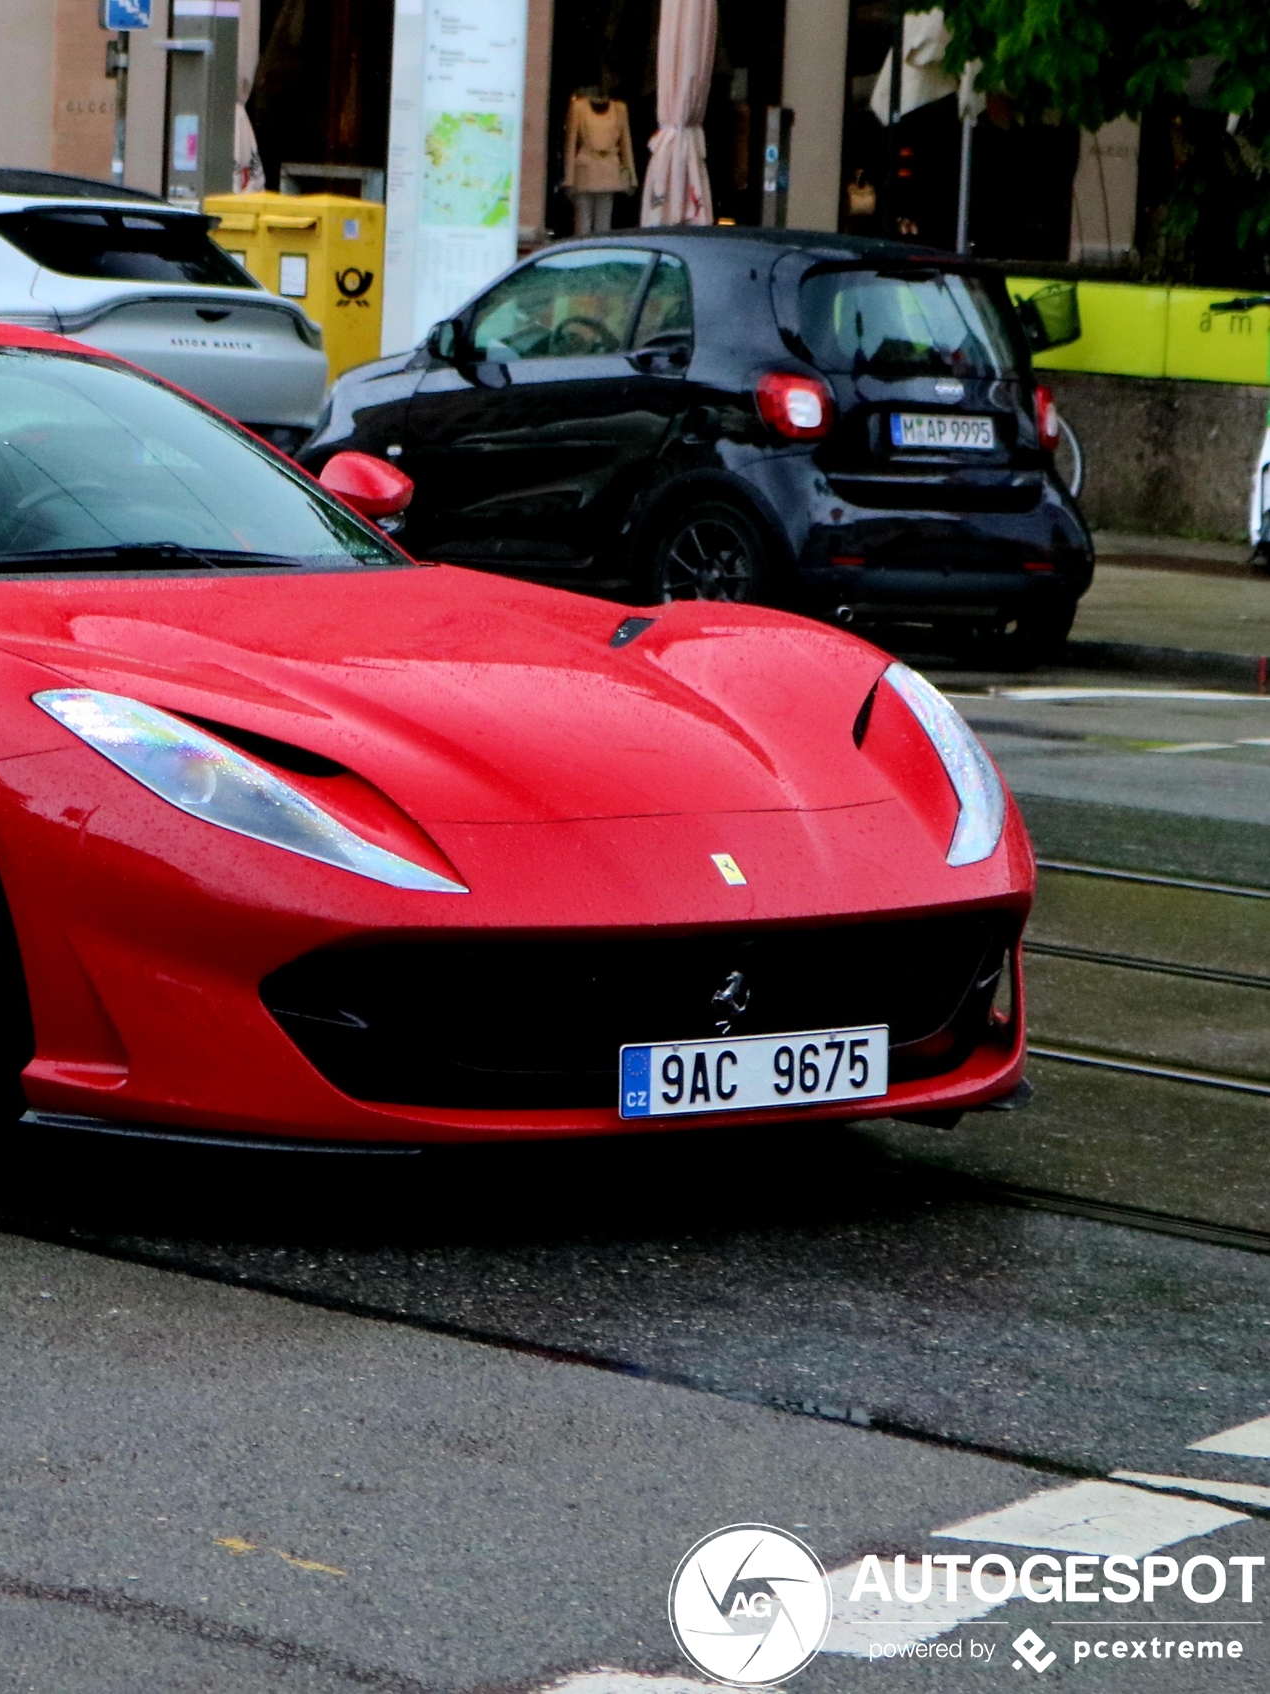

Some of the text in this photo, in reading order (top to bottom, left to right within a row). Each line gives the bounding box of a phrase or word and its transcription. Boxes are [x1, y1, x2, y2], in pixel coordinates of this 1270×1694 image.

[903, 418, 991, 444] M AP 9995
[661, 1038, 870, 1105] 9AC 9675
[626, 1091, 647, 1108] CZ
